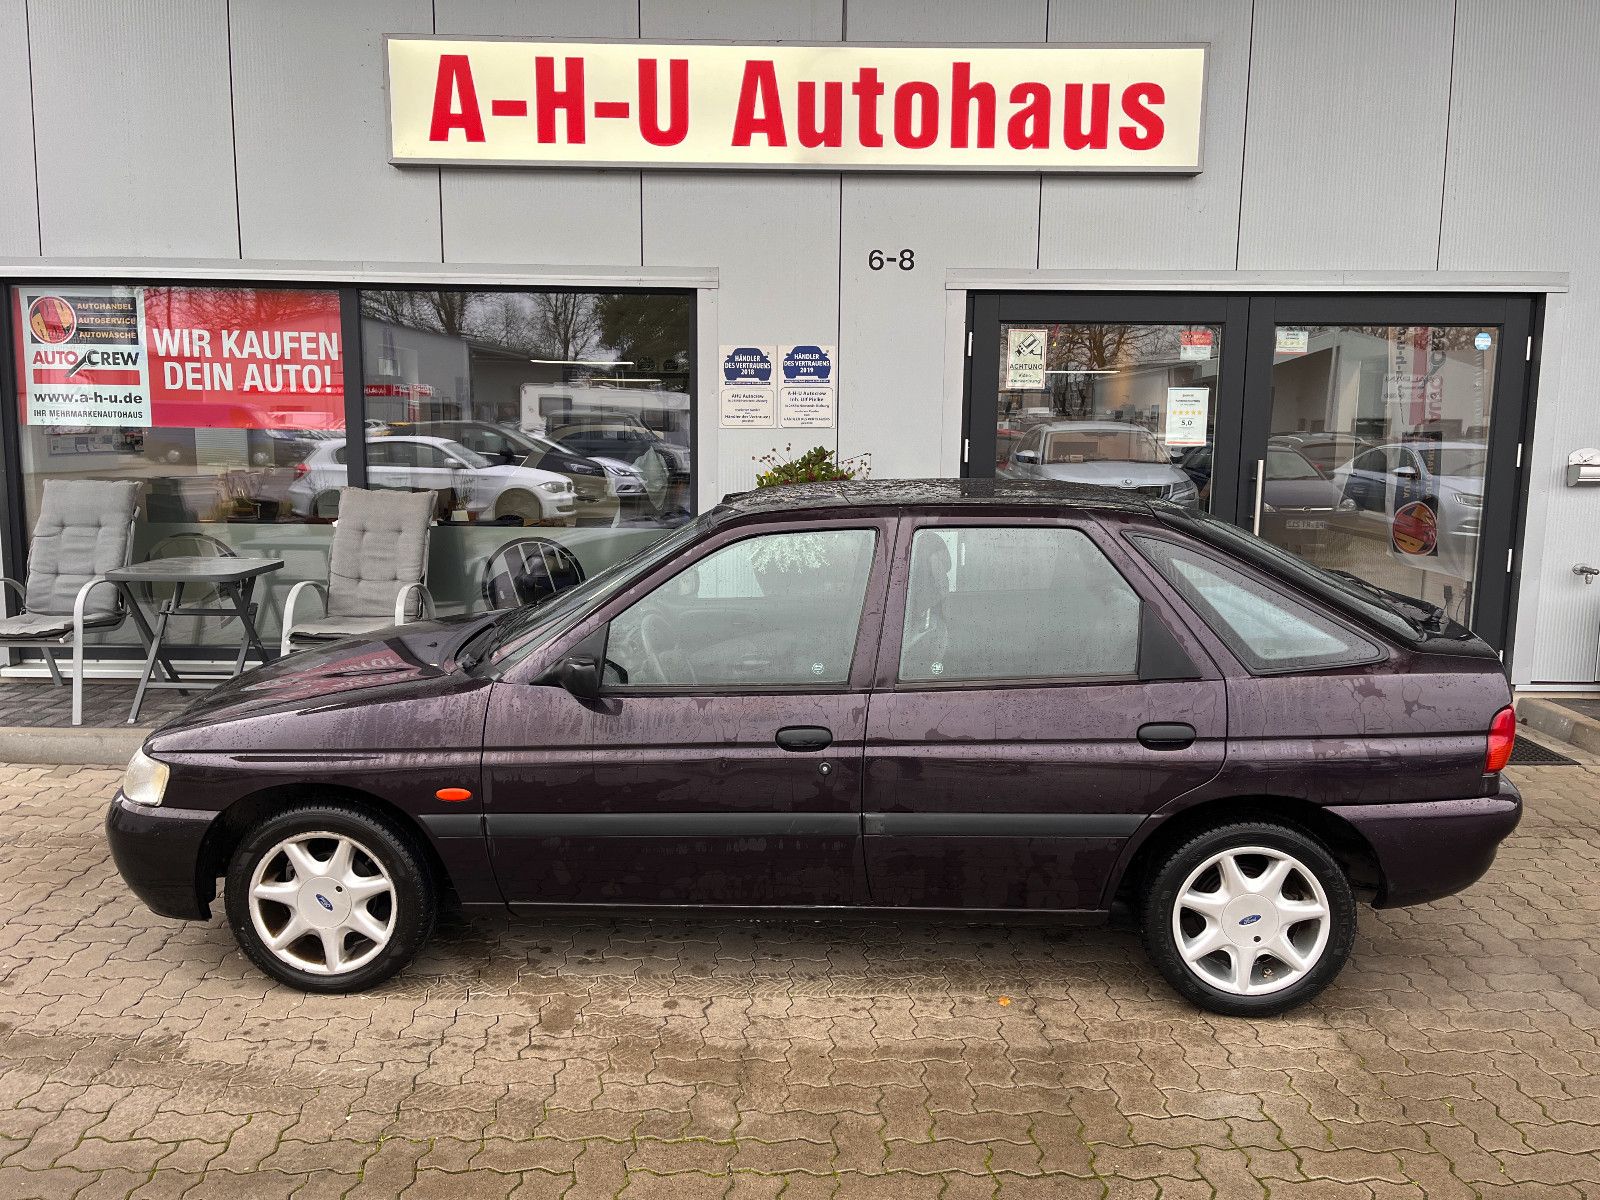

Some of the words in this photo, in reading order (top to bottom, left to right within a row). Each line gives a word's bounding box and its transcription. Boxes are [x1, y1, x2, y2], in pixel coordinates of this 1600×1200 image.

[429, 54, 689, 147] A-H-U
[731, 60, 1166, 150] Autohaus
[868, 248, 915, 271] 6-8
[152, 328, 212, 358] WIR
[221, 329, 339, 361] KAUFEN
[163, 361, 234, 391] DEIN
[243, 363, 332, 394] AUTO!
[34, 392, 143, 404] www.a-h-u.de
[33, 409, 47, 417] IHR
[49, 409, 143, 419] MEHRMARKENAUTOHAUS
